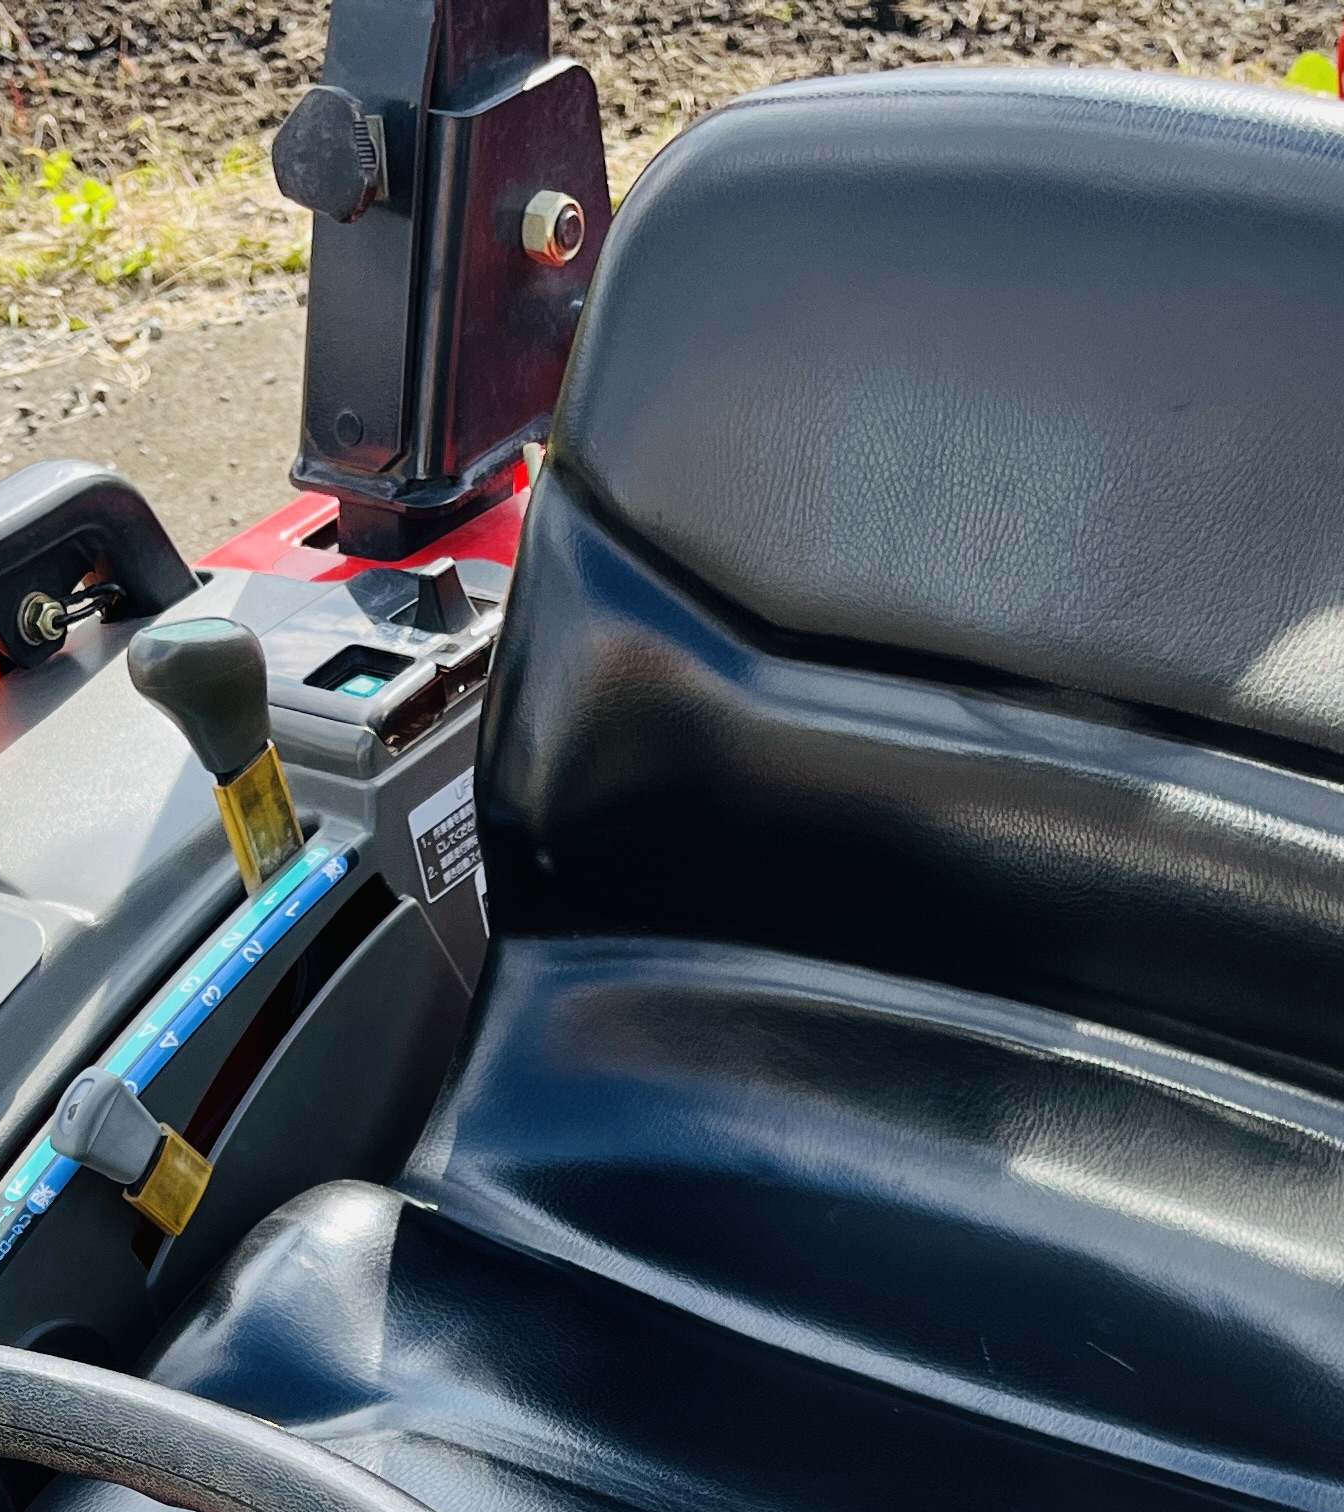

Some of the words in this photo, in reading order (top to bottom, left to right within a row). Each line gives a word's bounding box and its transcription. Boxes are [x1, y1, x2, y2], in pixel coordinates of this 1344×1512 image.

[284, 900, 301, 918] 1
[221, 931, 243, 948] 2
[242, 939, 264, 963] 2
[179, 975, 201, 993] 3
[201, 984, 222, 1007] 3
[137, 1021, 159, 1038] 4
[158, 1031, 179, 1049] 4
